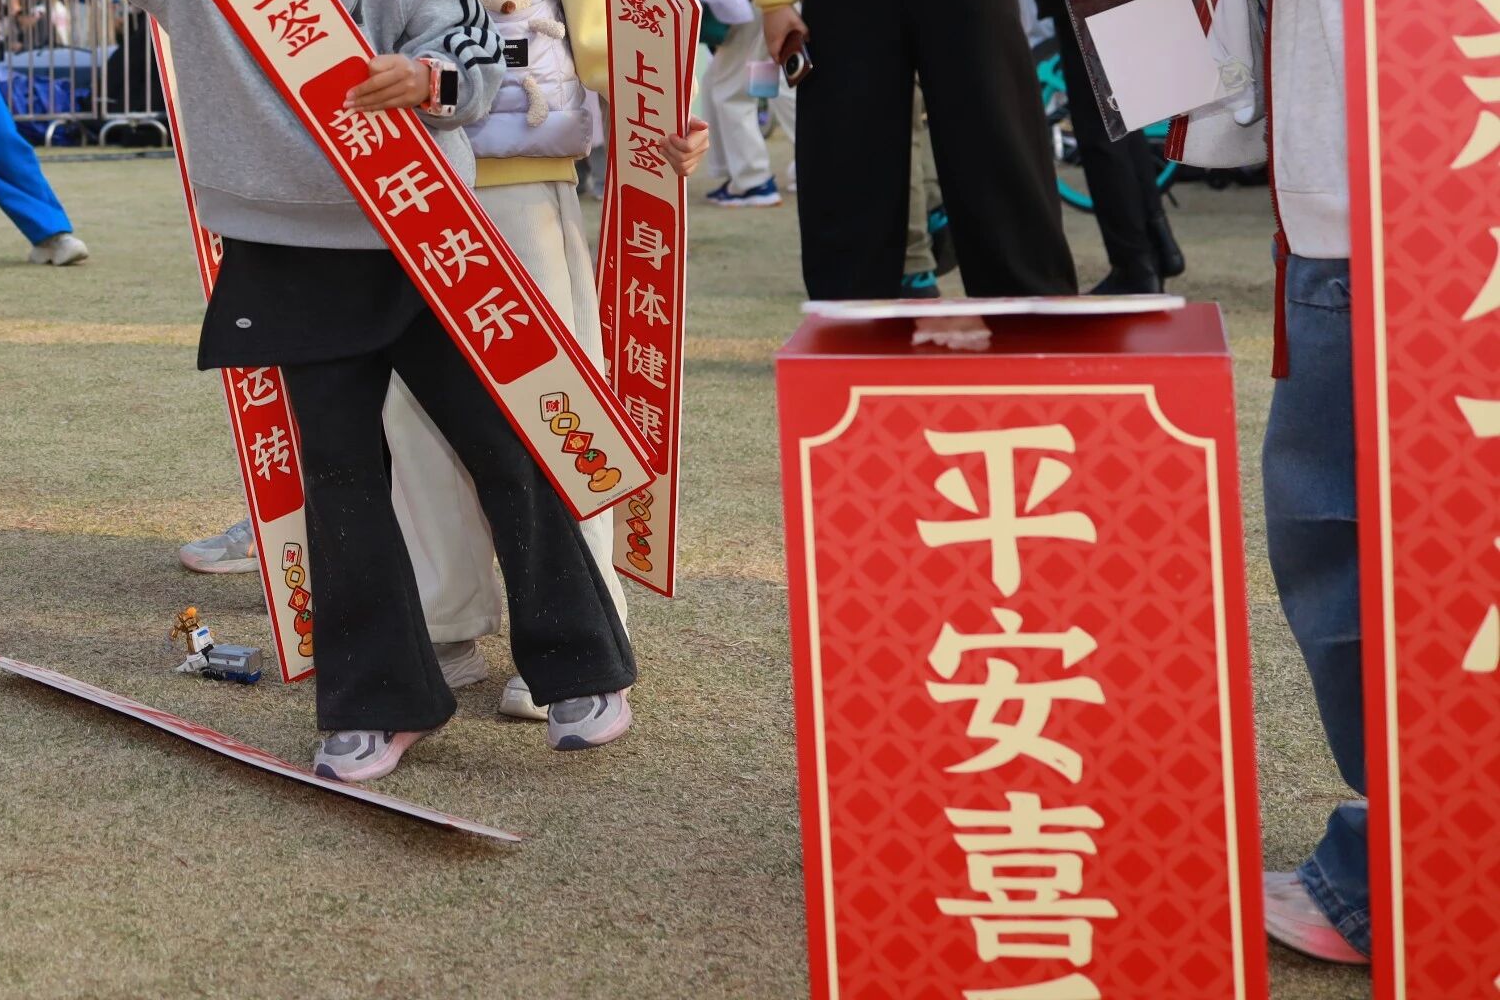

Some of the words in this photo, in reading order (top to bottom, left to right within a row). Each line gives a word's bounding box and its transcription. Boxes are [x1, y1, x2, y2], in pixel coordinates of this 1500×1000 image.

[624, 49, 668, 179] 上上签
[328, 106, 530, 353] 新年快乐
[623, 219, 672, 445] 身体健康
